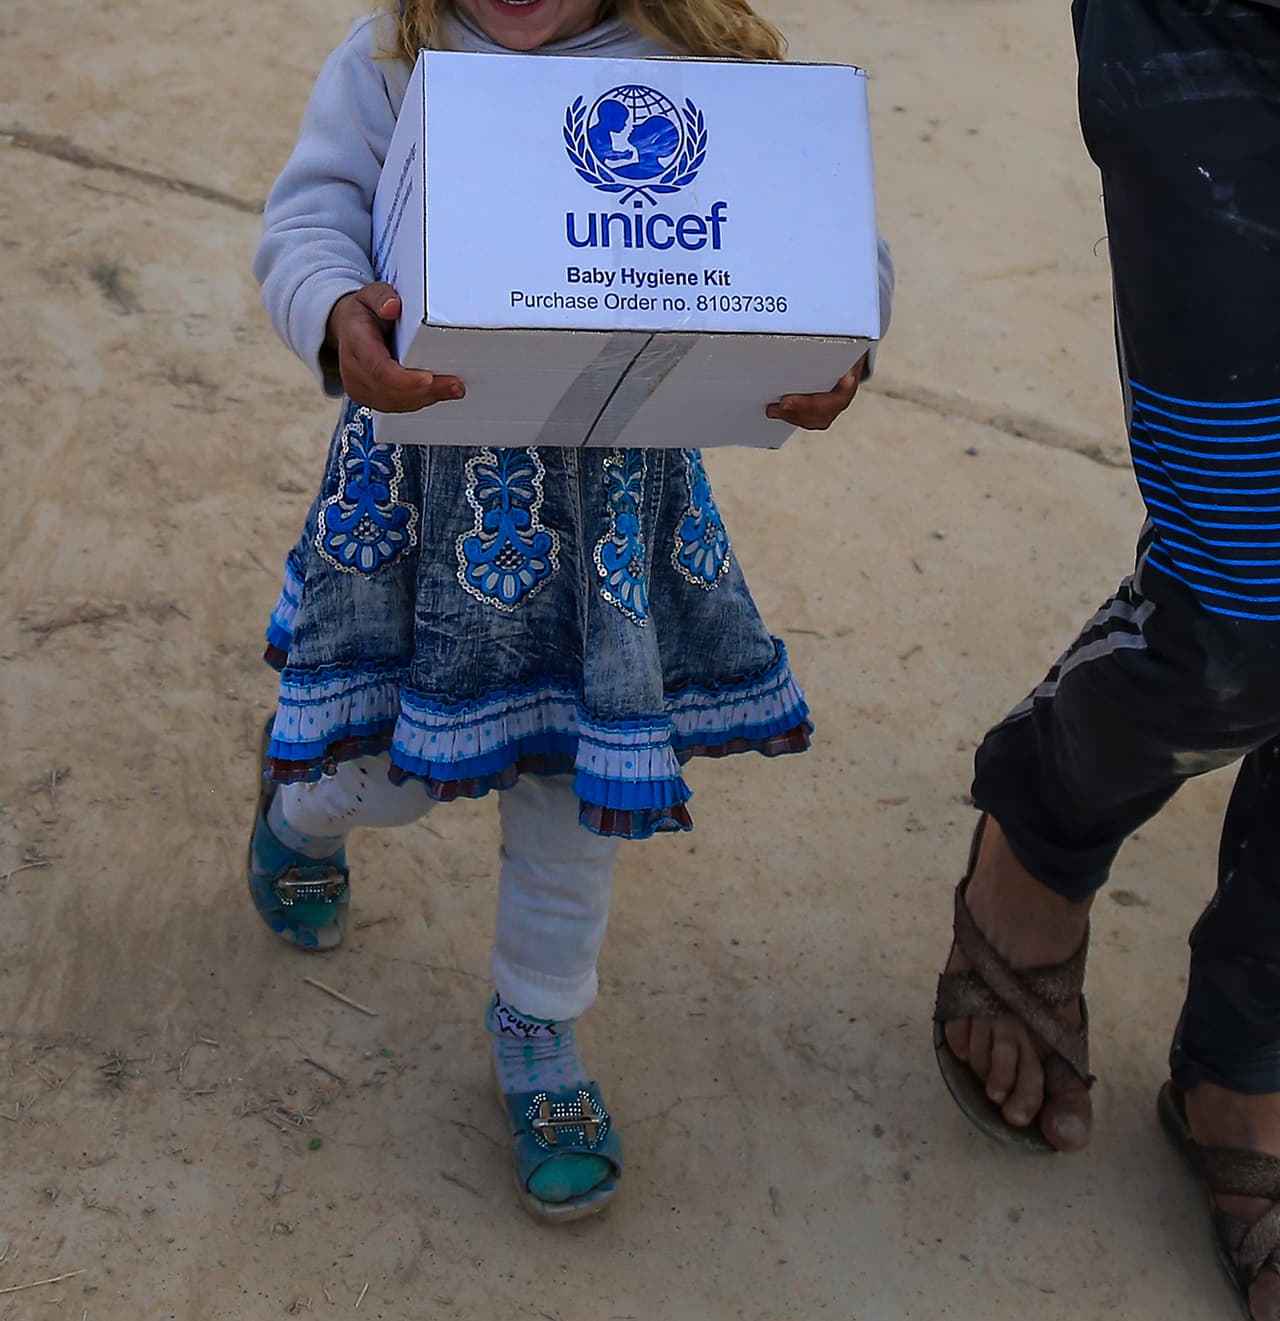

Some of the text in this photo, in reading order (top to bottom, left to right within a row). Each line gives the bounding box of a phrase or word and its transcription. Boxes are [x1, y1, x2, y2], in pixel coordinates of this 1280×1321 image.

[565, 200, 728, 251] unicef
[566, 266, 731, 289] Baby Hygiene Kit
[510, 291, 788, 313] Purchase Order no. 81037336
